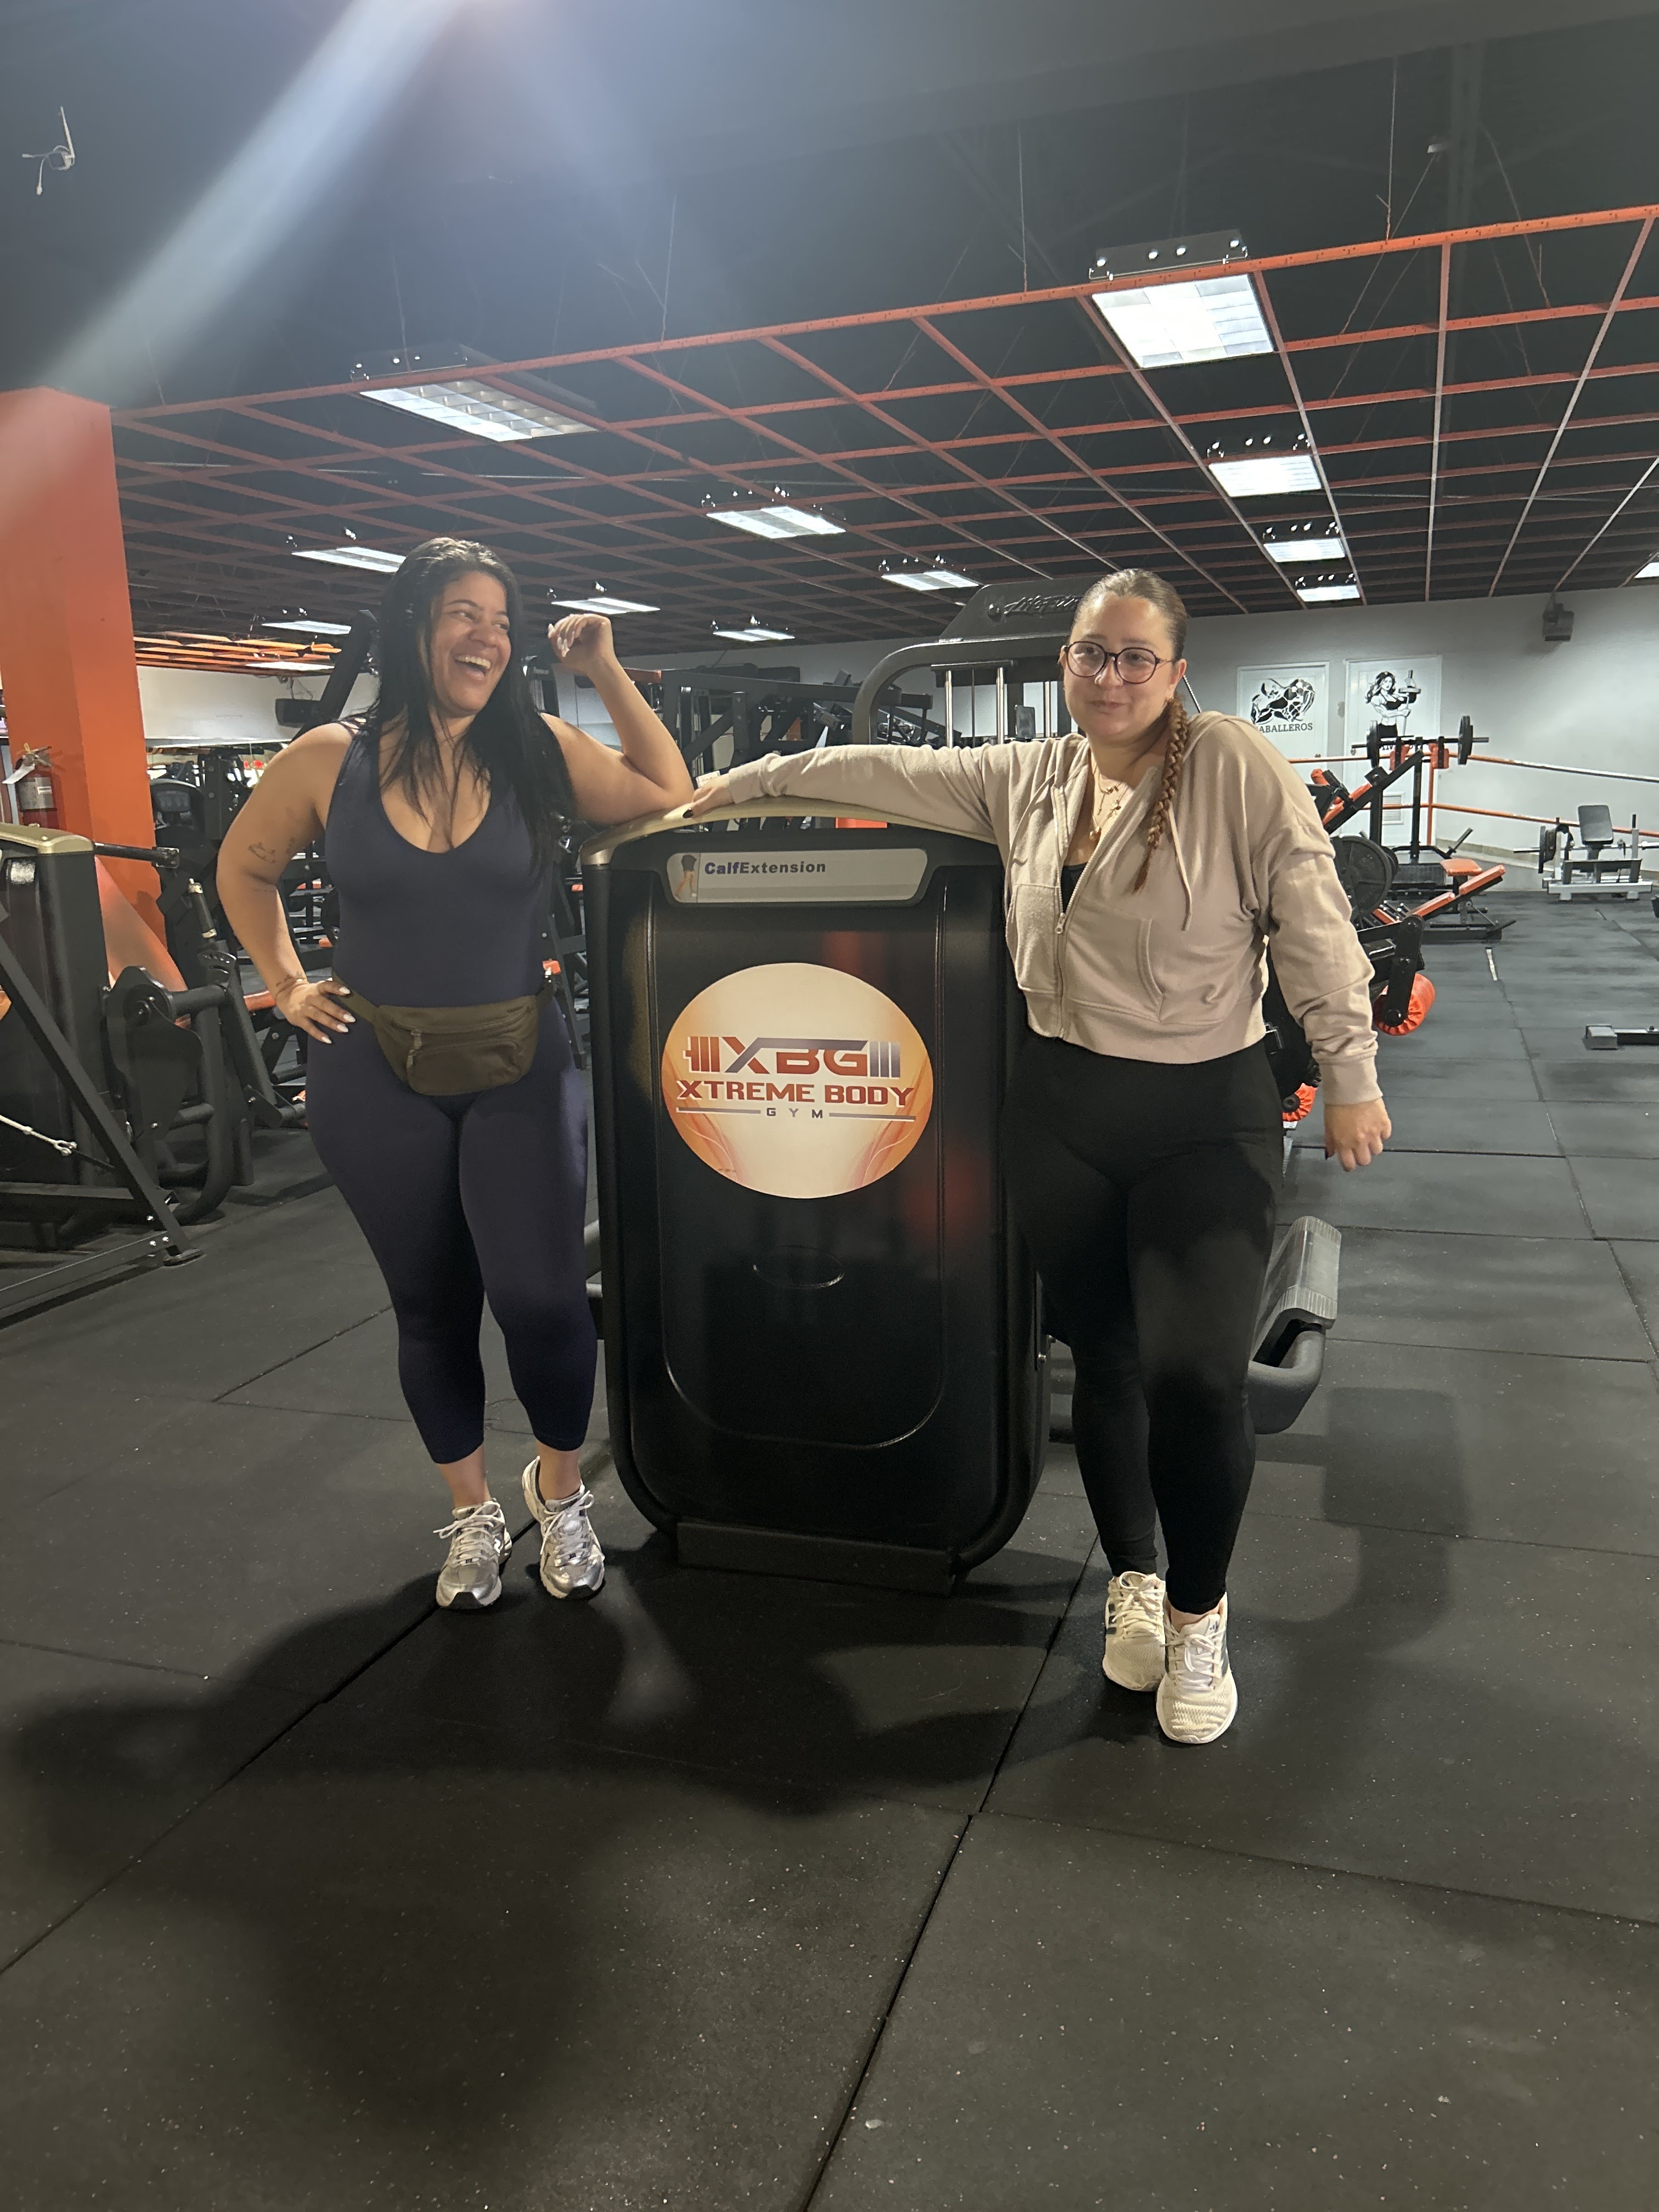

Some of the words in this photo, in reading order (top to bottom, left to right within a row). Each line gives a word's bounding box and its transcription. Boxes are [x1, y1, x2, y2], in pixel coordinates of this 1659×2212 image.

[1258, 723, 1313, 733] ABALLEROS
[704, 861, 826, 874] CalfExtension
[721, 1036, 868, 1077] XBG
[678, 1080, 815, 1103] XTREME
[824, 1085, 915, 1107] BODY
